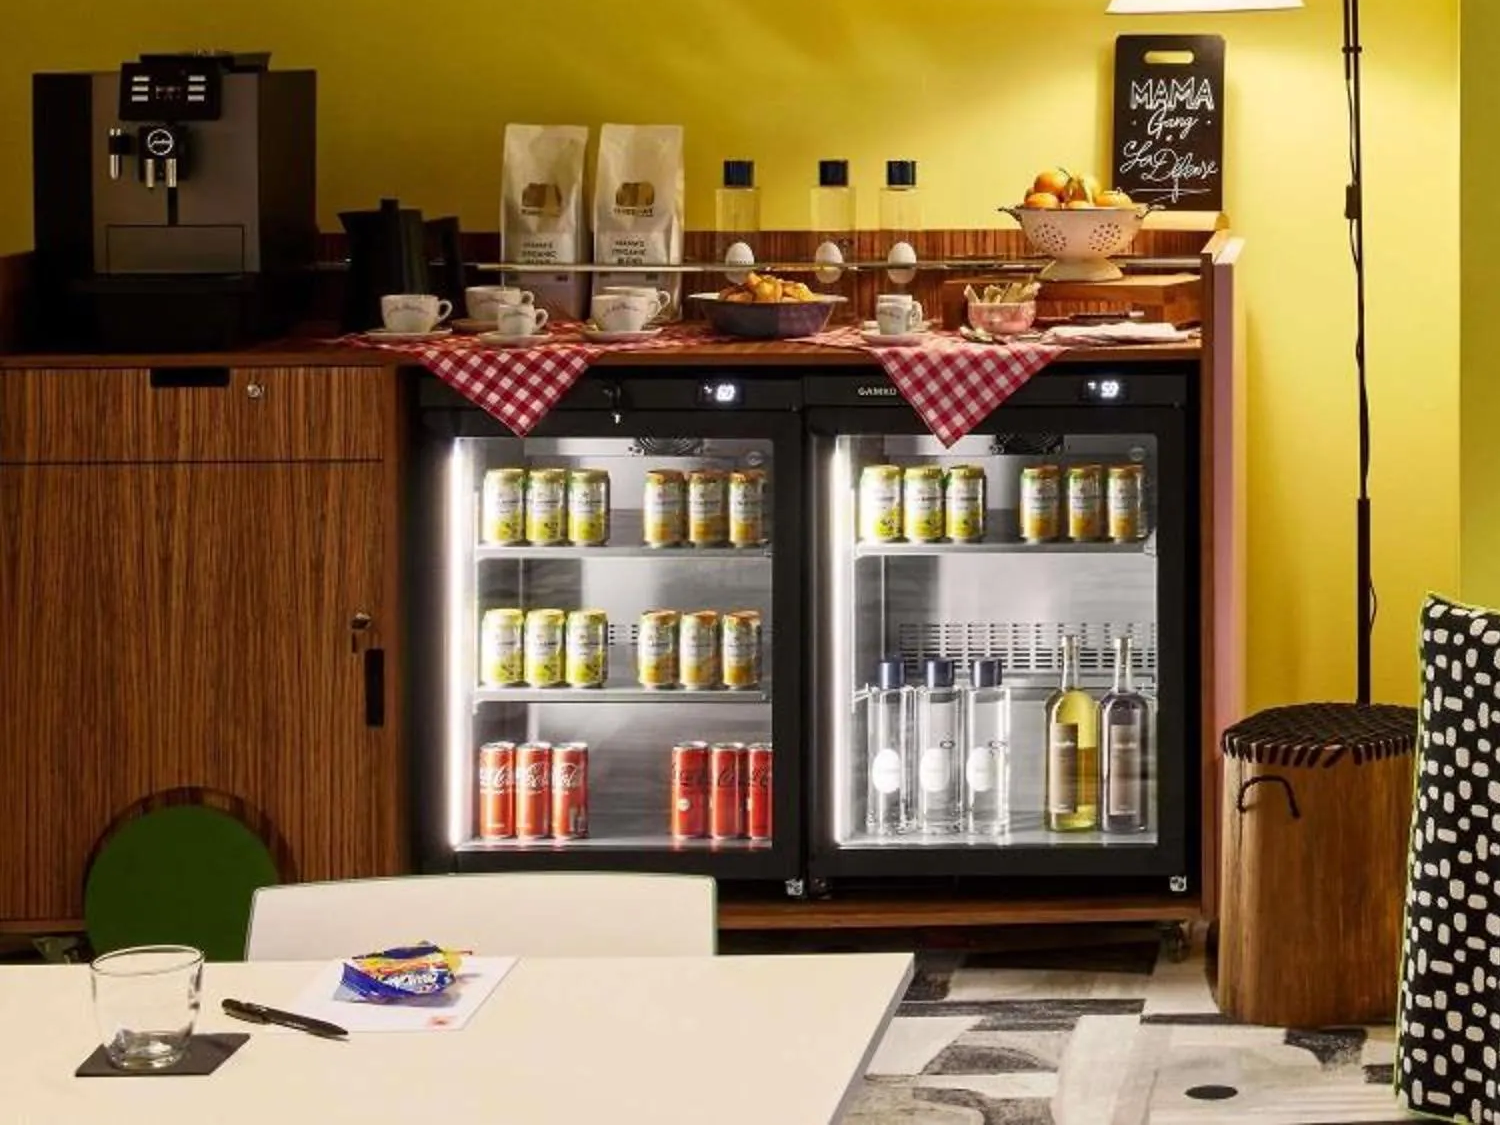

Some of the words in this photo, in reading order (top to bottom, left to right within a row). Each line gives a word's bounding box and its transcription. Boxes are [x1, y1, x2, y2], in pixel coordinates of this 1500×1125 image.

[1130, 76, 1215, 111] MAMA
[1147, 101, 1199, 140] Gang
[1119, 140, 1154, 174] La
